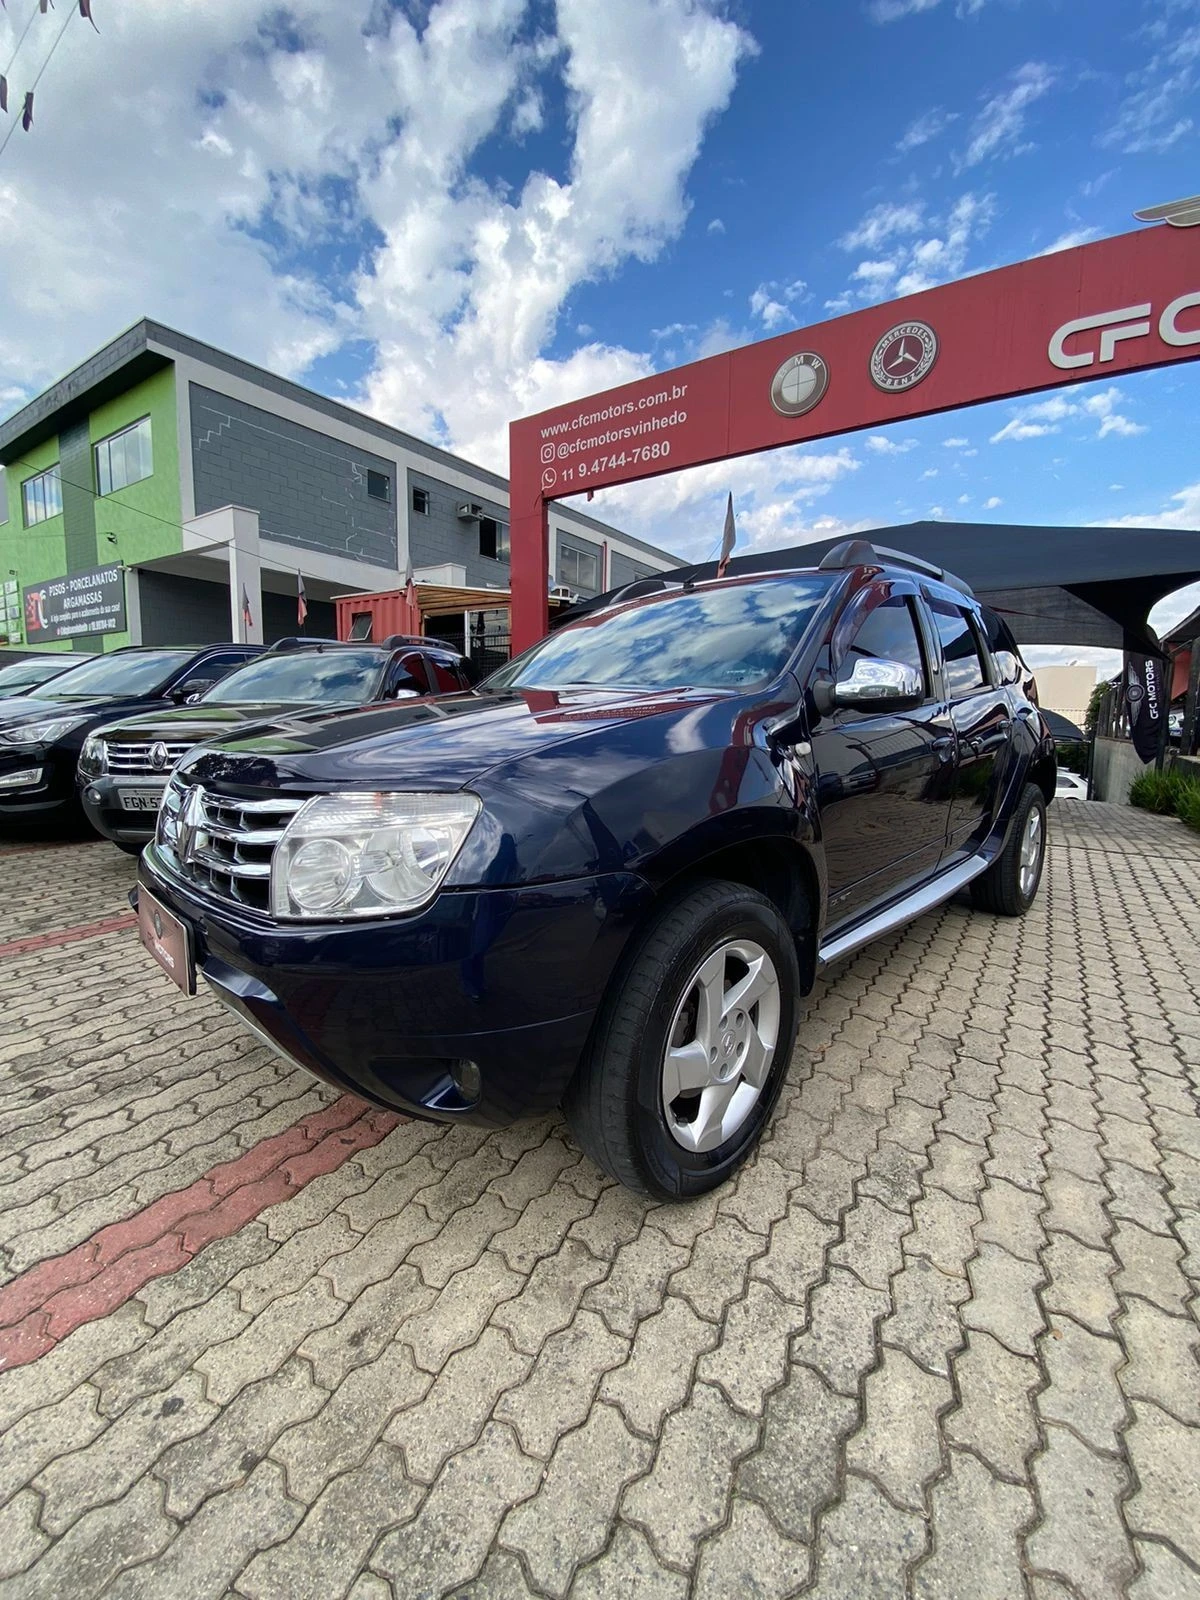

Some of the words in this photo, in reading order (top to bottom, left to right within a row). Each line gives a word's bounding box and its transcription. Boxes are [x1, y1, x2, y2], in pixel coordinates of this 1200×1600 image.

[881, 326, 927, 350] MERCEDES
[778, 355, 822, 379] BMW
[886, 372, 917, 386] BENZ
[541, 384, 688, 439] www.cfcmotors.com.br
[557, 411, 688, 459] @cfcmotorsvinhedo
[562, 468, 574, 481] 11
[578, 441, 670, 477] 9.4744-7680
[49, 583, 65, 596] PISOS
[69, 569, 118, 592] PORCELANATOS
[63, 590, 103, 610] ARGAMASSAS
[1145, 660, 1157, 701] MOTORS
[1149, 702, 1159, 720] CFC
